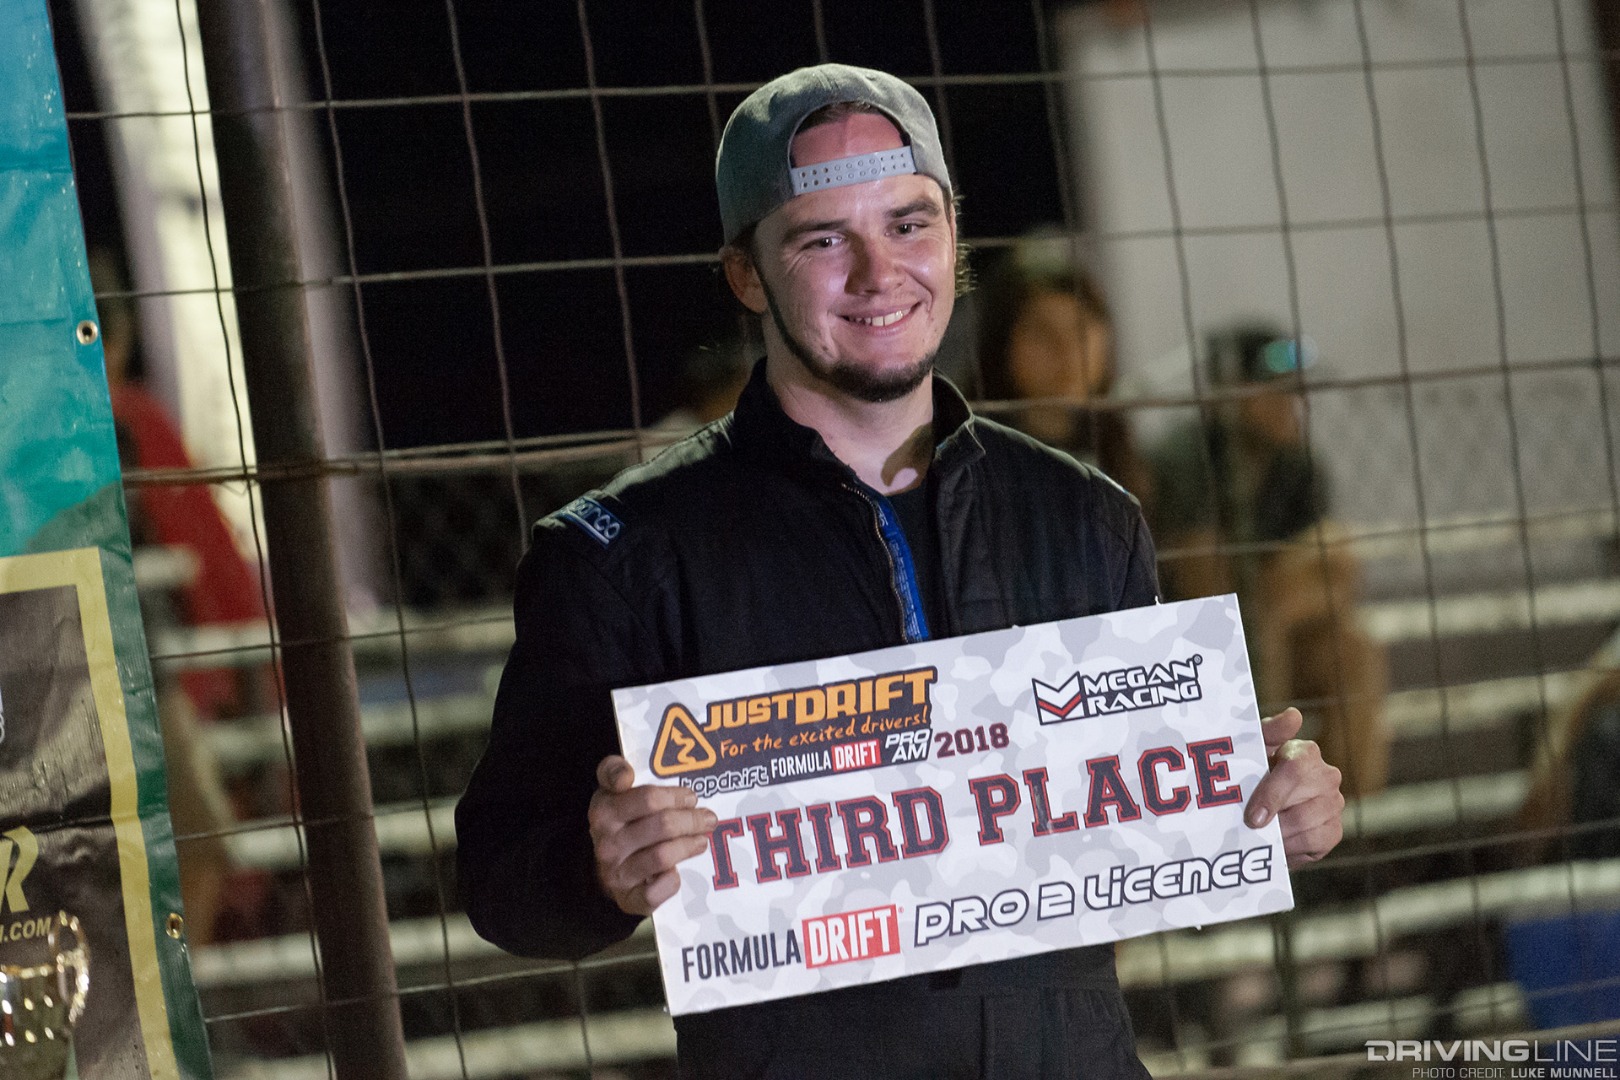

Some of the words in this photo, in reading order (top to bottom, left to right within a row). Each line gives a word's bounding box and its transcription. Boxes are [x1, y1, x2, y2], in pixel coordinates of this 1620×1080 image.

[1082, 659, 1196, 695] MEGAN
[1087, 680, 1199, 715] RACING
[719, 740, 748, 759] For
[752, 734, 782, 752] the
[789, 719, 851, 746] excited
[861, 705, 928, 734] drivers!
[771, 749, 832, 779] FORMULA
[834, 741, 878, 771] DRIFT
[933, 722, 1009, 759] 2018
[885, 730, 930, 749] PRO
[891, 742, 928, 763] AM
[709, 786, 950, 892] THIRD
[967, 736, 1243, 848] PLACE
[914, 888, 1031, 948] PRO
[1037, 881, 1076, 921] 2
[681, 929, 802, 983] FORMULA
[807, 907, 893, 965] DRIFT
